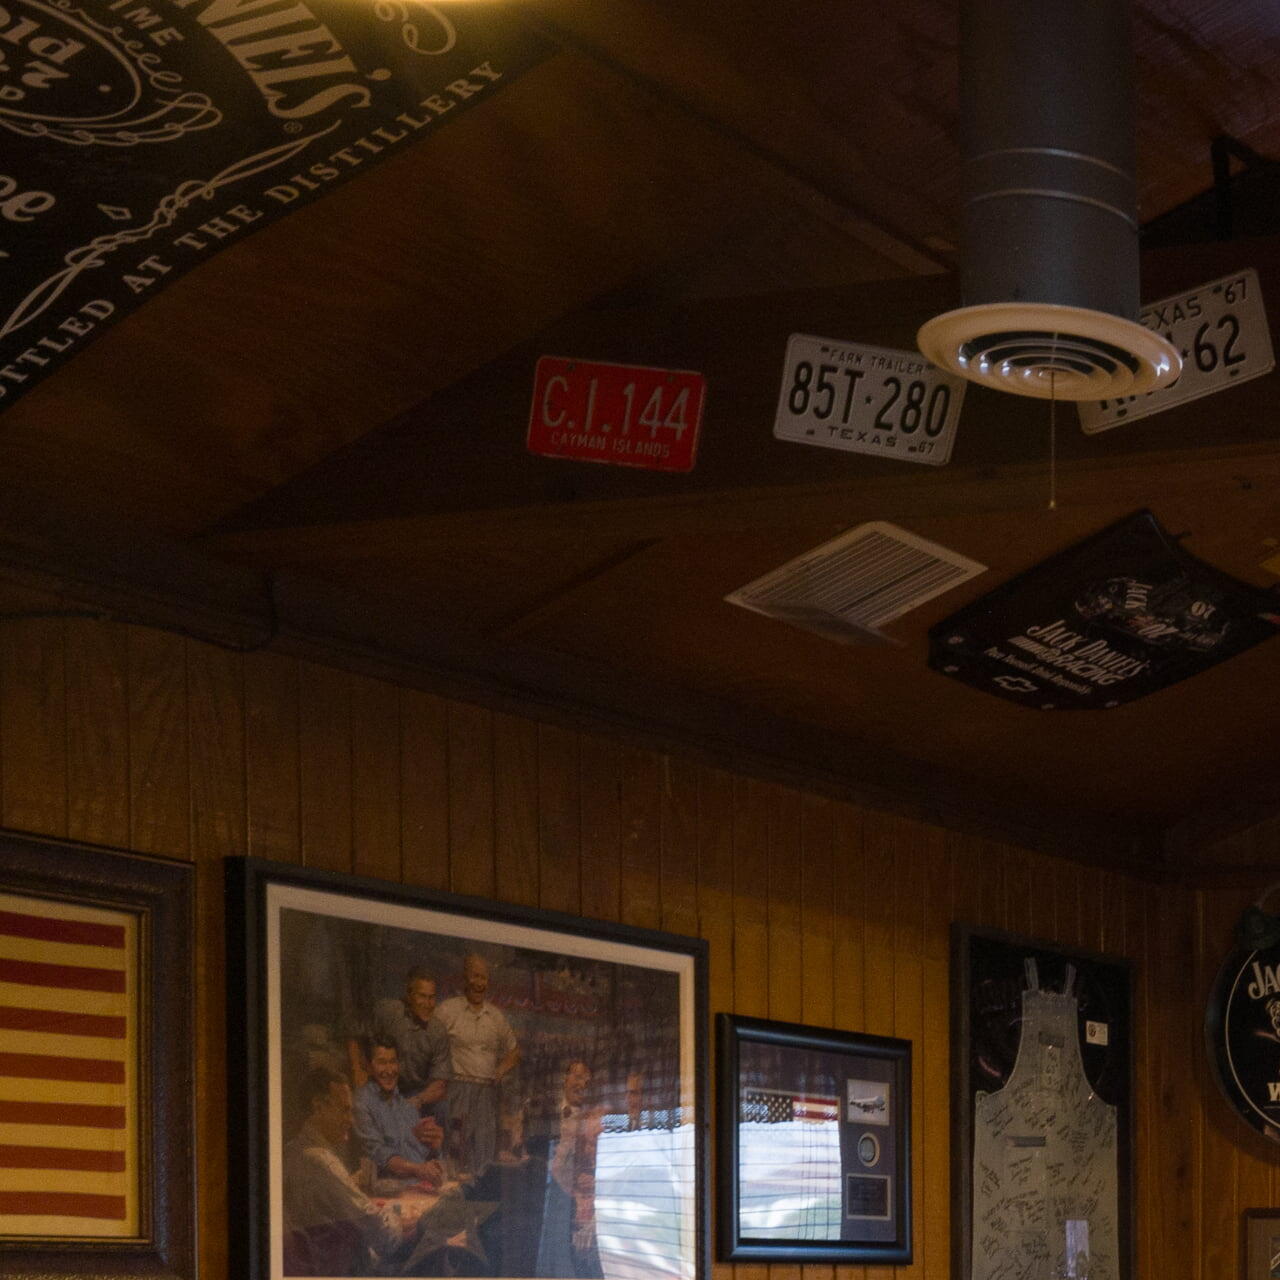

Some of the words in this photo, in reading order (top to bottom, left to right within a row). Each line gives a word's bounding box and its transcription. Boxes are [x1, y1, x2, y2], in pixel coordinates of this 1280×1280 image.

[122, 255, 173, 294] AT
[173, 204, 264, 250] THE
[264, 60, 502, 204] DISTILLERY
[1223, 278, 1247, 304] 67
[871, 355, 924, 375] TRAILER
[788, 360, 865, 425] 85T
[874, 376, 952, 438] 280
[550, 431, 606, 451] CAYMAN
[612, 440, 671, 458] ISLANDS
[828, 426, 898, 447] TEXAS
[1026, 619, 1086, 652] JACK
[1072, 637, 1151, 678] DANIEL'S
